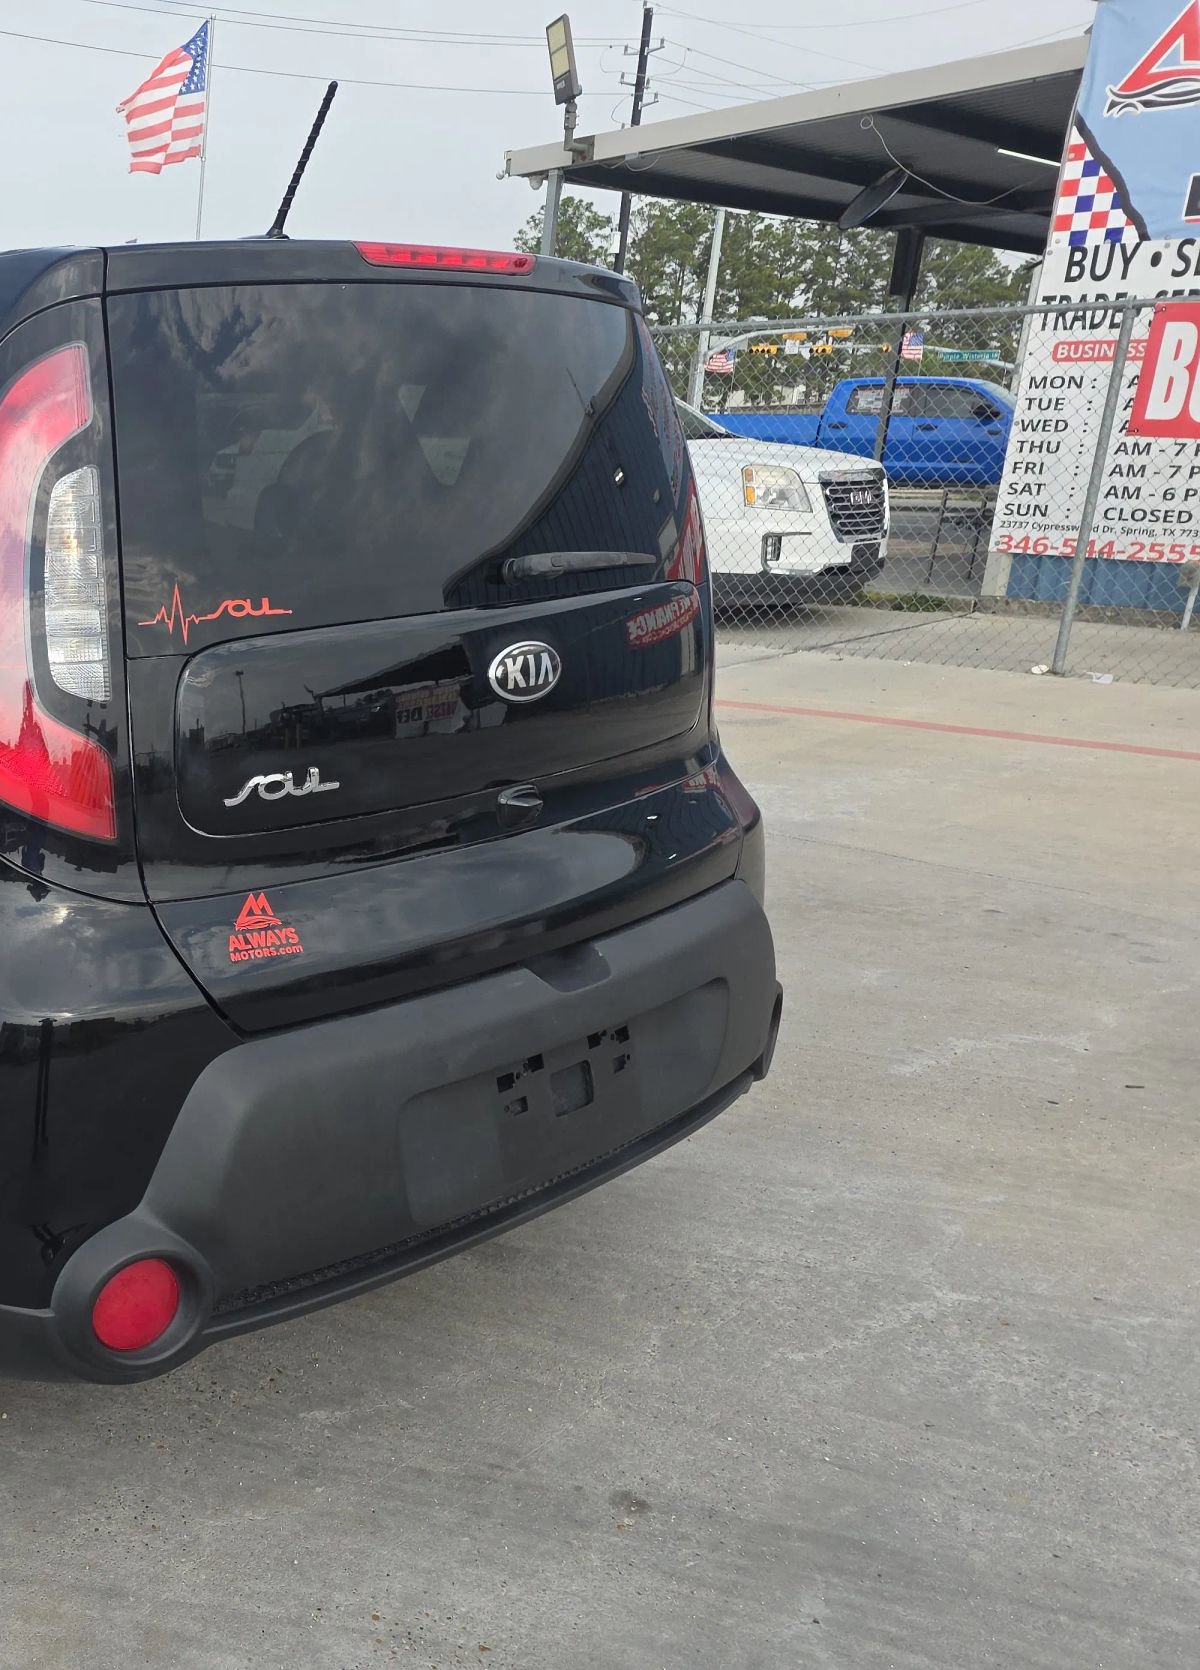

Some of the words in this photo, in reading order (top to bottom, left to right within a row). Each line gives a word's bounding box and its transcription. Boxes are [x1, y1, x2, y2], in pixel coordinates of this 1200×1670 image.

[1064, 240, 1144, 284] BUY
[1041, 291, 1129, 332] TRADE
[1056, 342, 1147, 359] BUSINSS
[1144, 321, 1200, 422] B
[1028, 375, 1084, 390] MON
[1127, 375, 1140, 389] A
[1025, 397, 1066, 411] TUE
[1122, 397, 1135, 412] A
[1020, 419, 1069, 433] WED
[1017, 440, 1061, 454] THU
[1113, 442, 1152, 457] AM
[1174, 442, 1188, 457] 7
[1012, 461, 1045, 475] FRI
[1108, 464, 1147, 478] AM
[1168, 465, 1182, 478] 7
[1007, 482, 1046, 496] SAT
[1103, 485, 1142, 500] AM
[1162, 487, 1176, 501] 6
[1183, 488, 1200, 503] P
[1003, 503, 1049, 517] SUN
[1103, 507, 1193, 524] CLOSED
[1000, 520, 1029, 529] 23737
[1031, 521, 1099, 533] Cypresswd
[1162, 528, 1176, 536] TX
[504, 652, 554, 690] KIA
[228, 927, 299, 952] ALWAYS
[230, 944, 304, 962] MOTORS.com
